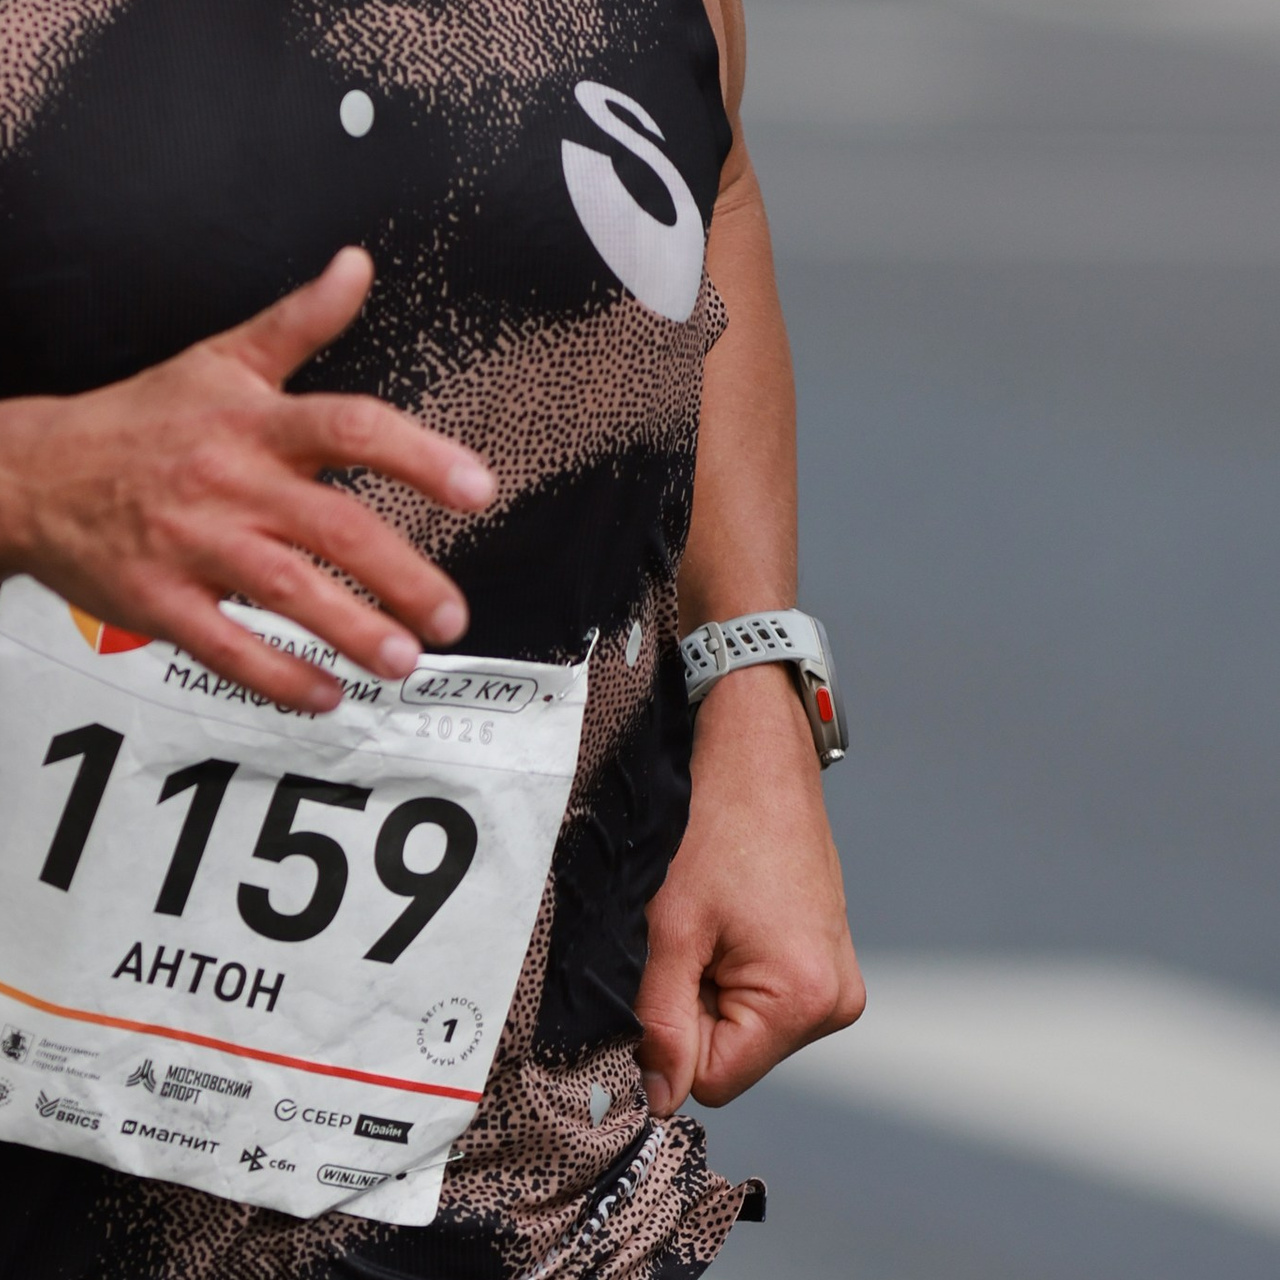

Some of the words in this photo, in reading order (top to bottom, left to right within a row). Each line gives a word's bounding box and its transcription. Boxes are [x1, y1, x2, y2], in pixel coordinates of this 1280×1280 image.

[416, 678, 472, 700] 42,2
[415, 712, 494, 745] 2026
[38, 722, 478, 965] 1159
[111, 941, 286, 1013] АНТОН
[442, 1018, 458, 1043] 1
[160, 1081, 202, 1104] СПОРТ
[165, 1065, 253, 1099] МОСКОВСКИЙ
[55, 1109, 100, 1131] BRICS
[302, 1108, 352, 1128] СБЕР
[361, 1120, 403, 1138] Прайм
[138, 1123, 220, 1154] магнит
[269, 1159, 297, 1173] сбп
[323, 1168, 378, 1187] WINLINE
